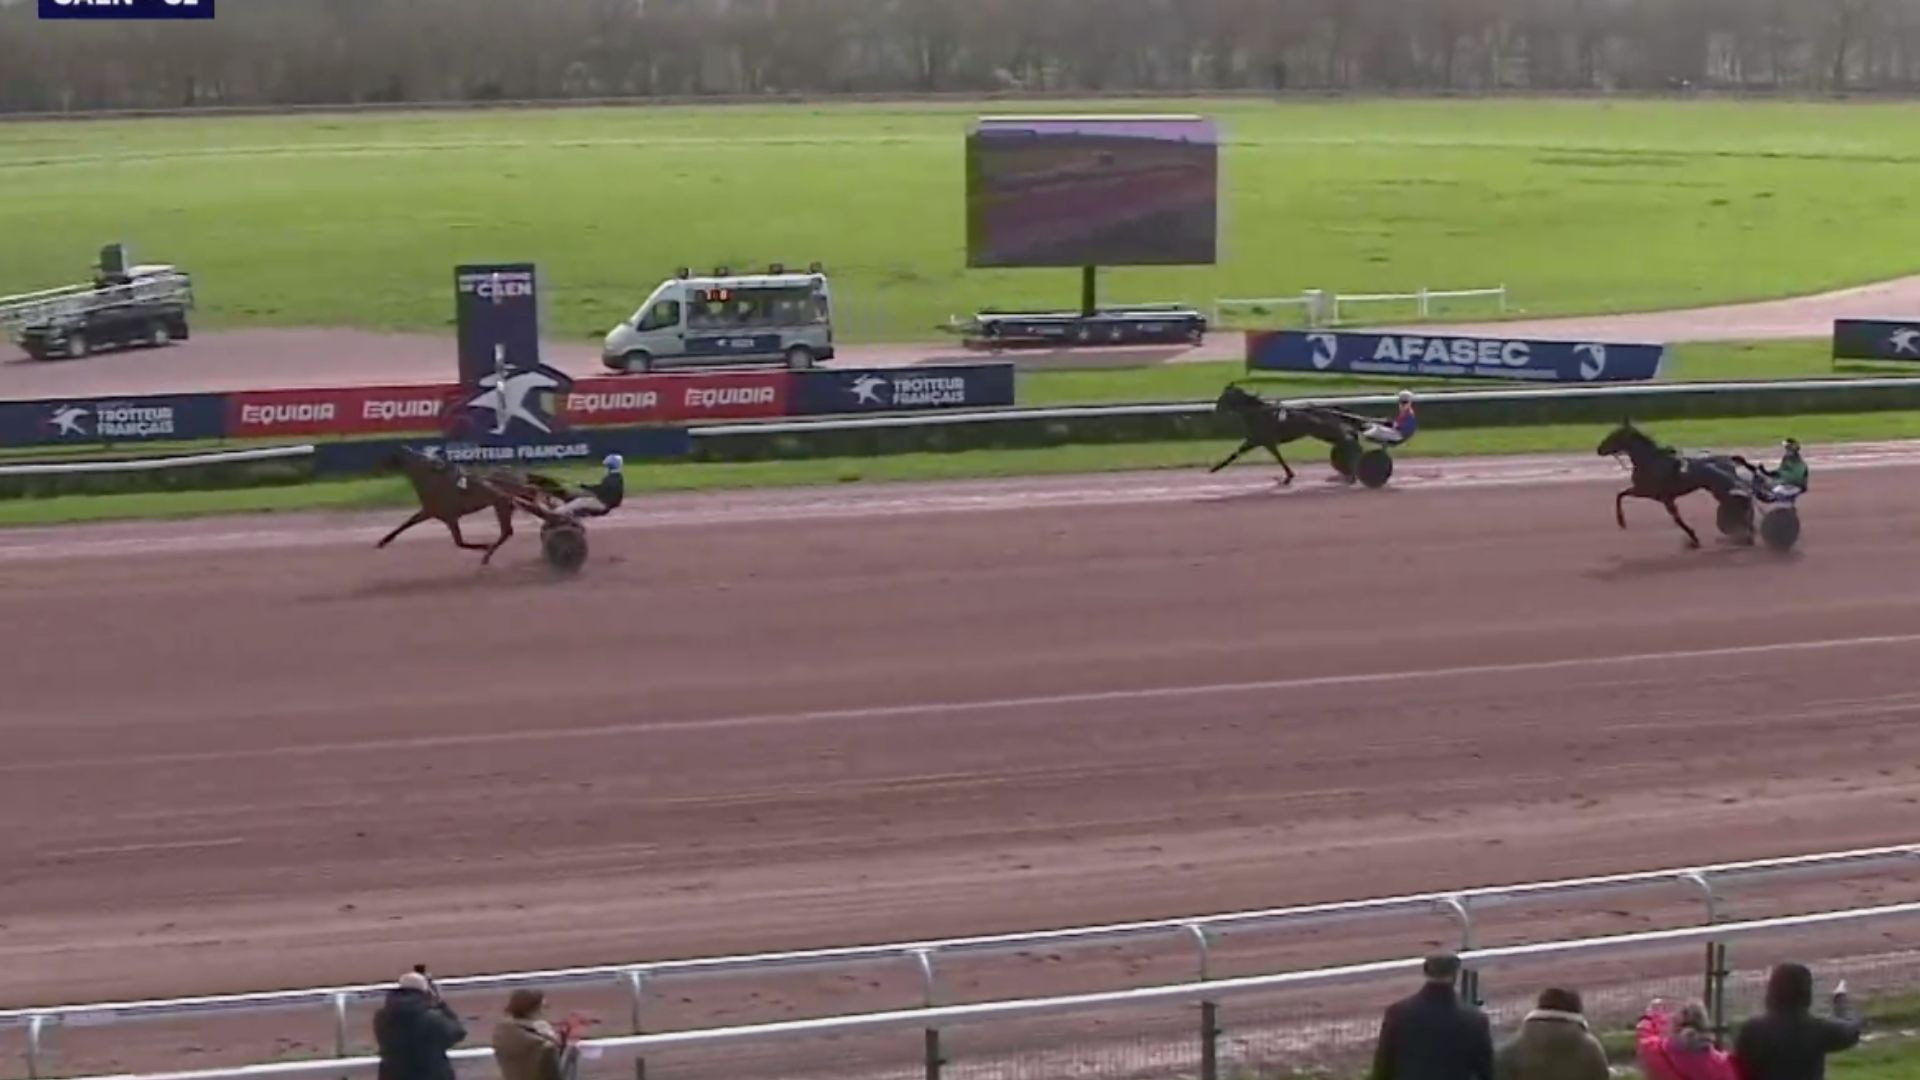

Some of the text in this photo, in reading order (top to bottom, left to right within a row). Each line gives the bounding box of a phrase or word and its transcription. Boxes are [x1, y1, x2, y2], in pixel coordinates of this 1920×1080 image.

[1373, 337, 1530, 366] AFASEC
[894, 377, 965, 393] TROTTEUR
[567, 391, 657, 413] EQUIDIA
[685, 387, 774, 408] EQUIDIA
[892, 390, 966, 407] FRANÇAIS
[97, 408, 174, 422] TROTTEUR
[241, 403, 334, 425] EQUIDIA
[362, 400, 443, 420] EQUIDI
[97, 420, 174, 436] FRANÇAIS
[446, 443, 589, 461] TROTTEUR FRANÇAIS
